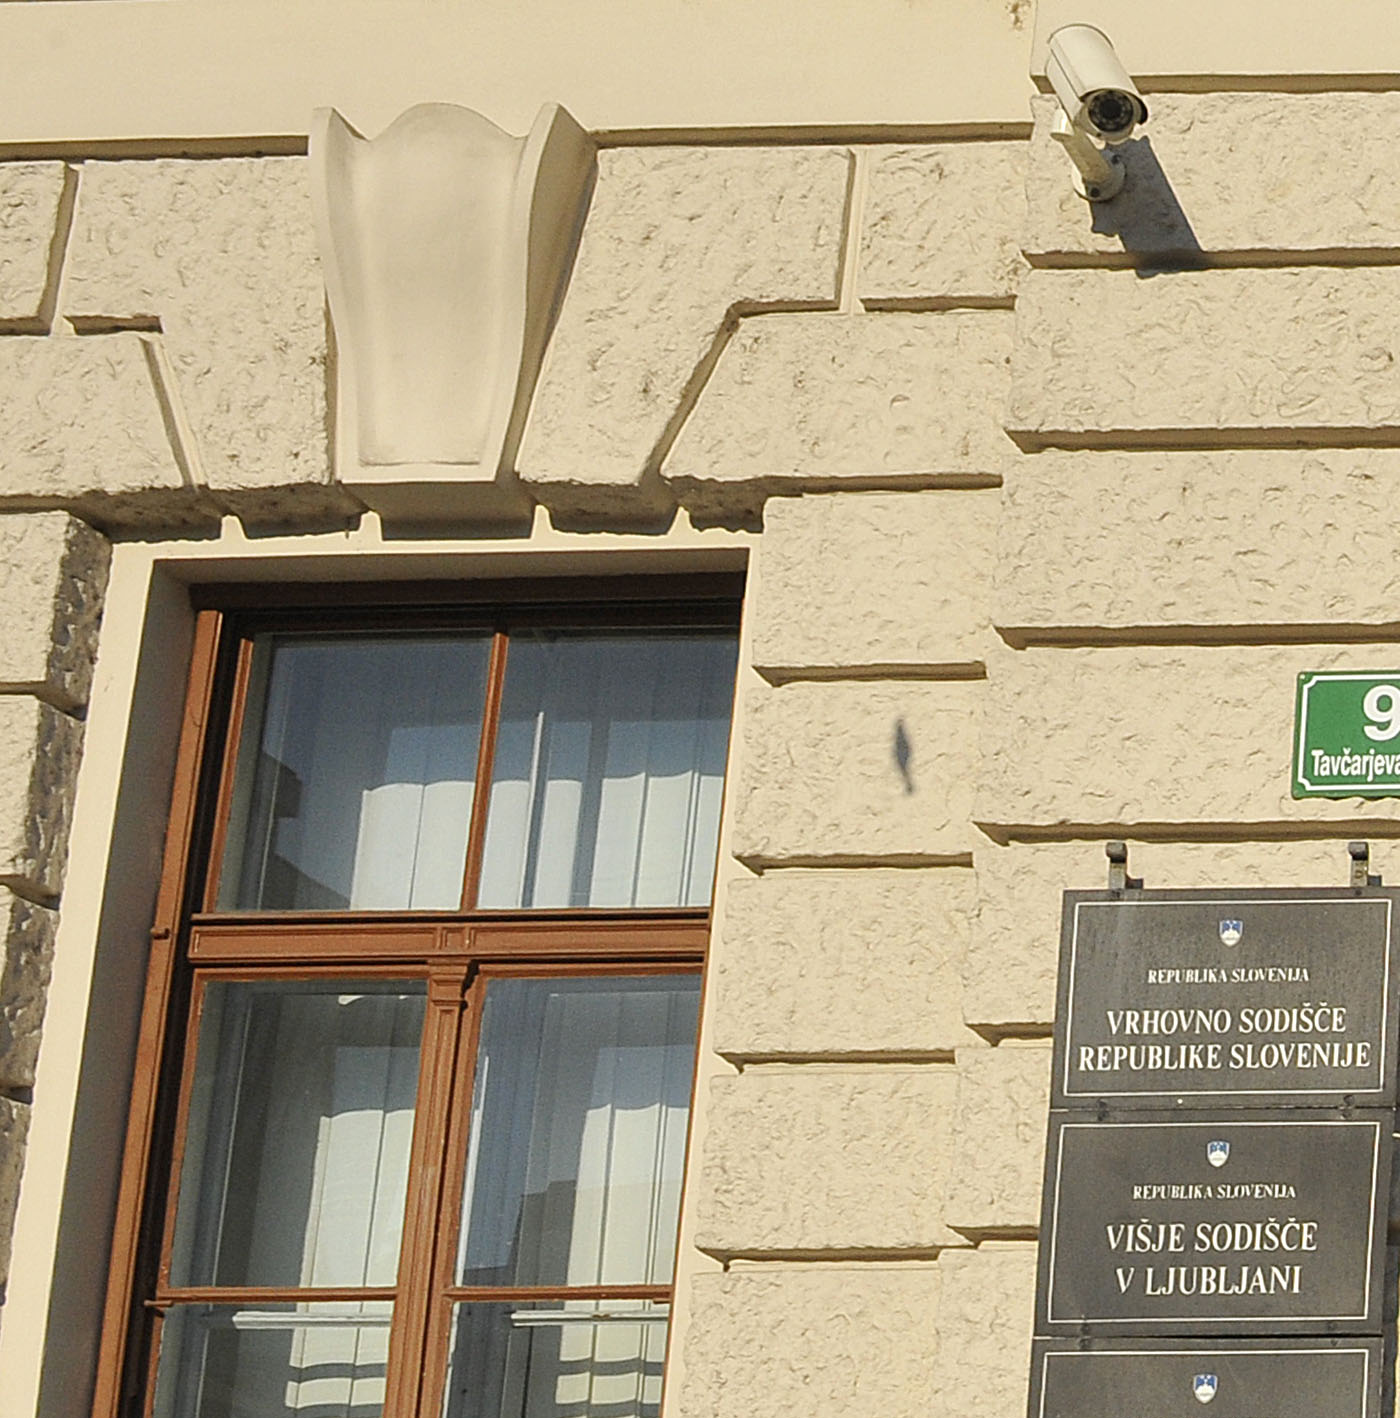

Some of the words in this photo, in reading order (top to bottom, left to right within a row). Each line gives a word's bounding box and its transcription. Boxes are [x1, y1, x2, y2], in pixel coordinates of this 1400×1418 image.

[1148, 969, 1227, 983] REPUBLIKA
[1231, 968, 1308, 982] SLOVENIJA
[1107, 1009, 1231, 1034] VRHOVNO
[1239, 1002, 1346, 1033] SODIŠČE
[1079, 1045, 1221, 1070] REPUBLIKE
[1230, 1042, 1370, 1068] SLOVENIJE
[1134, 1185, 1212, 1199] REPUBLIKA
[1217, 1184, 1295, 1198] SLOVENIJA
[1107, 1219, 1185, 1252] VIŠJE
[1195, 1218, 1317, 1251] SODIŠČE
[1116, 1267, 1135, 1294] V
[1146, 1266, 1300, 1294] LJUBLJANI
